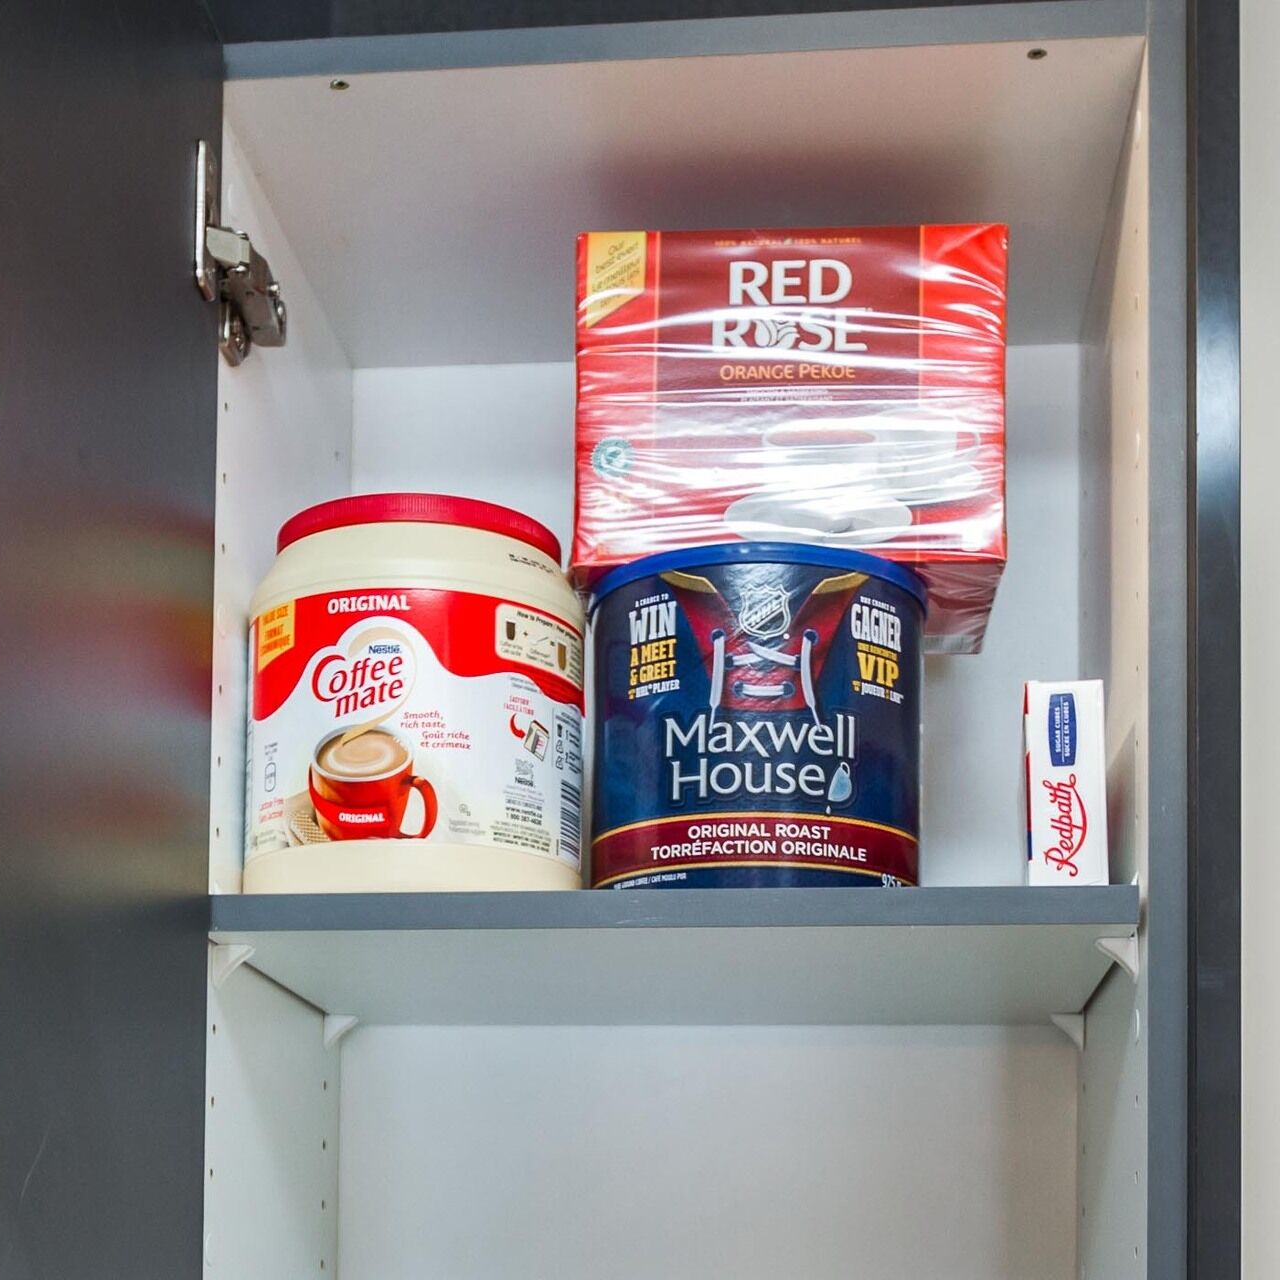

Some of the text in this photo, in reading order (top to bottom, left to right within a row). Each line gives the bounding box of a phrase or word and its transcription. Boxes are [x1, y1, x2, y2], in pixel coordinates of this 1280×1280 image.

[729, 259, 853, 306] RED
[711, 307, 869, 352] ROSE
[719, 363, 856, 381] ORANGE PEKOE
[327, 594, 411, 614] ORIGINAL
[628, 600, 677, 645] WIN
[851, 602, 902, 653] GAGNER
[630, 638, 677, 668] A MEET
[312, 654, 404, 702] Coffee
[639, 659, 677, 683] GREET
[856, 652, 899, 688] VIP
[652, 678, 680, 694] PLAYER
[334, 679, 404, 718] mate
[403, 710, 444, 721] Smooth,
[421, 721, 446, 729] taste
[447, 731, 470, 741] riche
[665, 713, 855, 759] Maxwell
[1063, 724, 1070, 734] EN
[420, 740, 472, 750] et crémeux
[671, 758, 825, 800] House
[338, 812, 386, 824] ORIGINAL
[1042, 773, 1087, 877] Redpath
[687, 822, 831, 840] ORIGINAL ROAST
[651, 839, 867, 862] TORRÉFACTION ORIGINALE
